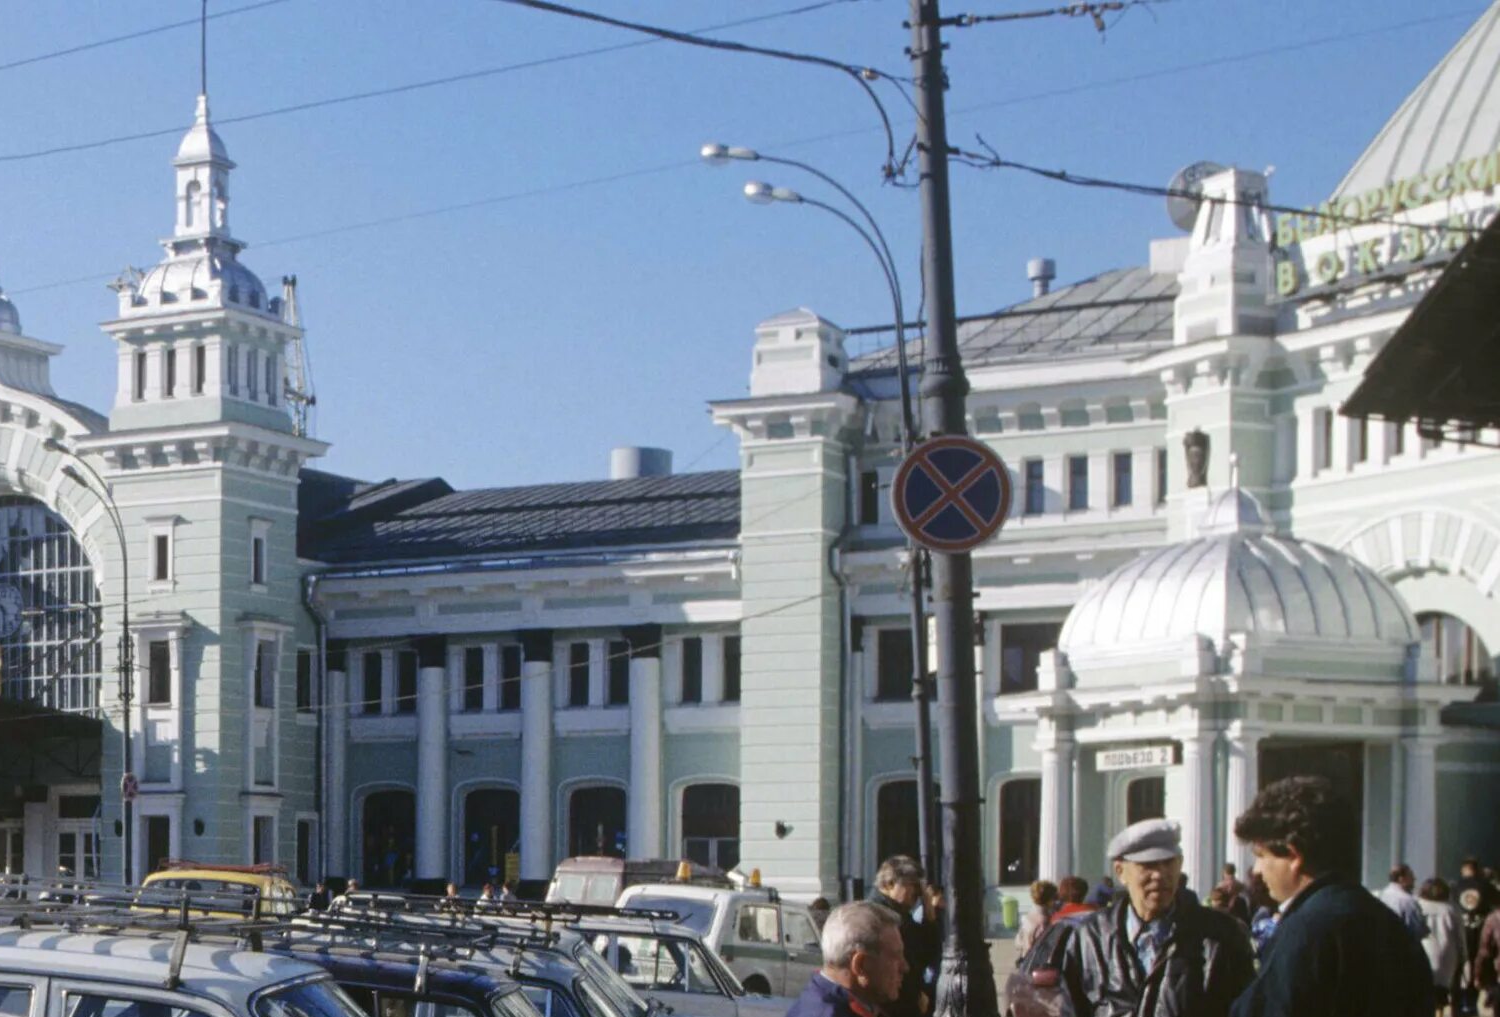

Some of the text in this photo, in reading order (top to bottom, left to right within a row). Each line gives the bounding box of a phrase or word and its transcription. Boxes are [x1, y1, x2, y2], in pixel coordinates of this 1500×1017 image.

[1277, 150, 1500, 247] БЕЛОРУССКИ
[1277, 212, 1468, 295] ВОКЗА
[1160, 747, 1168, 763] 2
